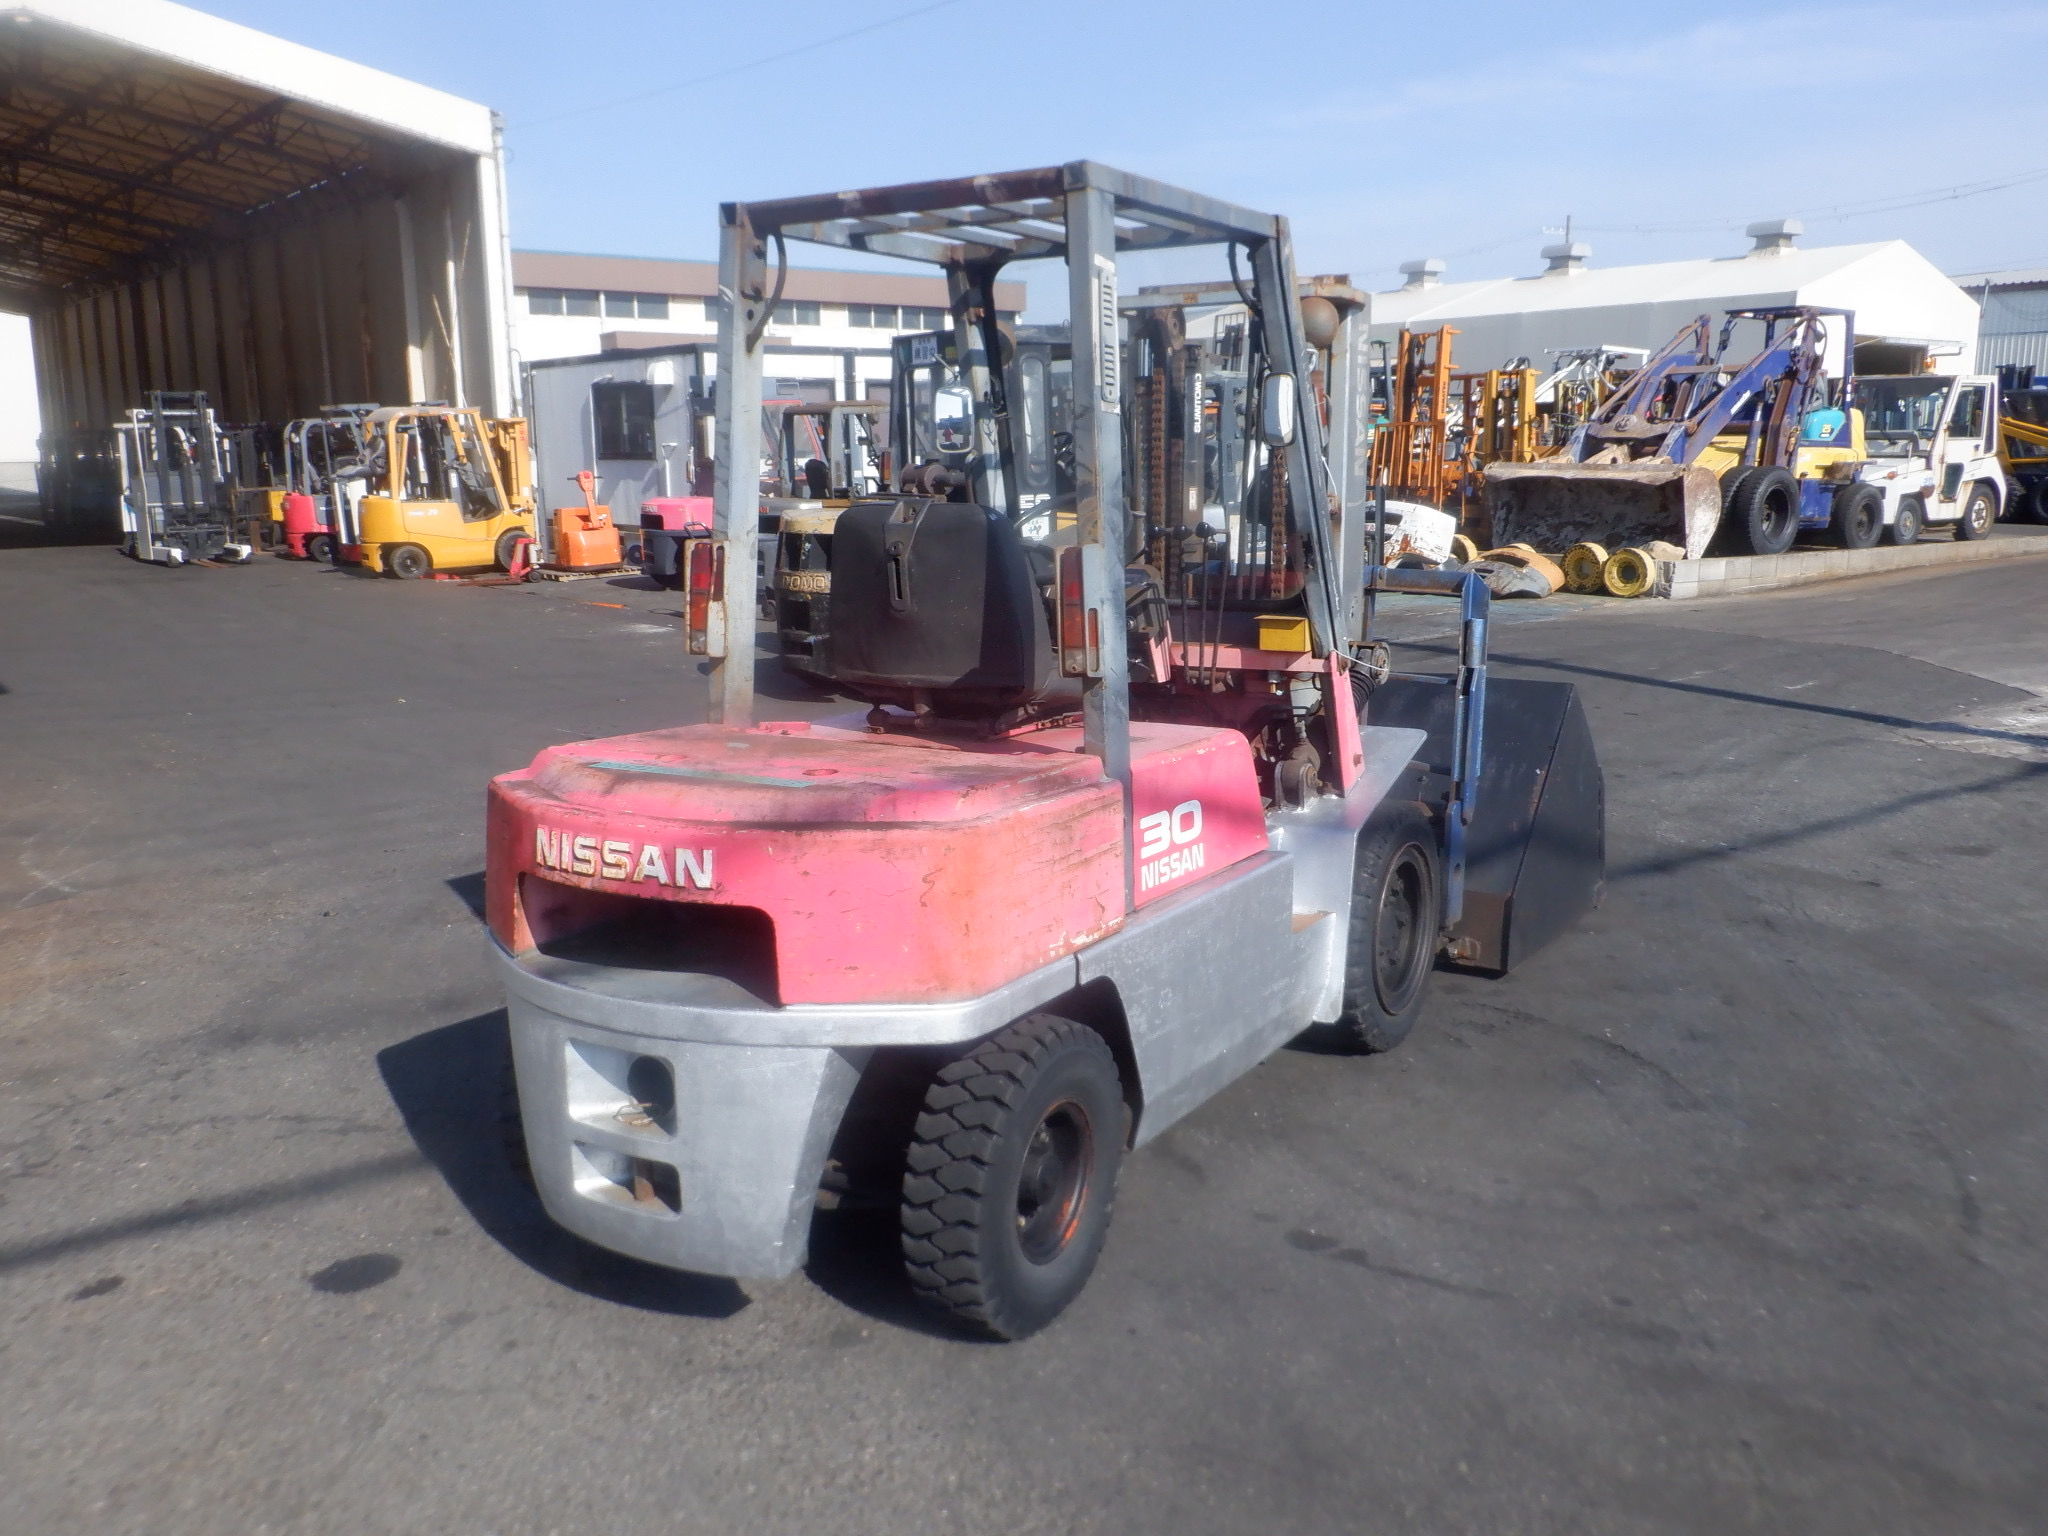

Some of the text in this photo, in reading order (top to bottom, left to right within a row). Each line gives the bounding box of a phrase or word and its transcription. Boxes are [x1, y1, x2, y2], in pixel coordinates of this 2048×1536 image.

[1194, 373, 1202, 433] SUMITOMO
[1354, 324, 1369, 476] NISSAN
[535, 827, 713, 889] NISSAN
[1139, 799, 1203, 859] 30
[1141, 842, 1204, 892] NISSAN
